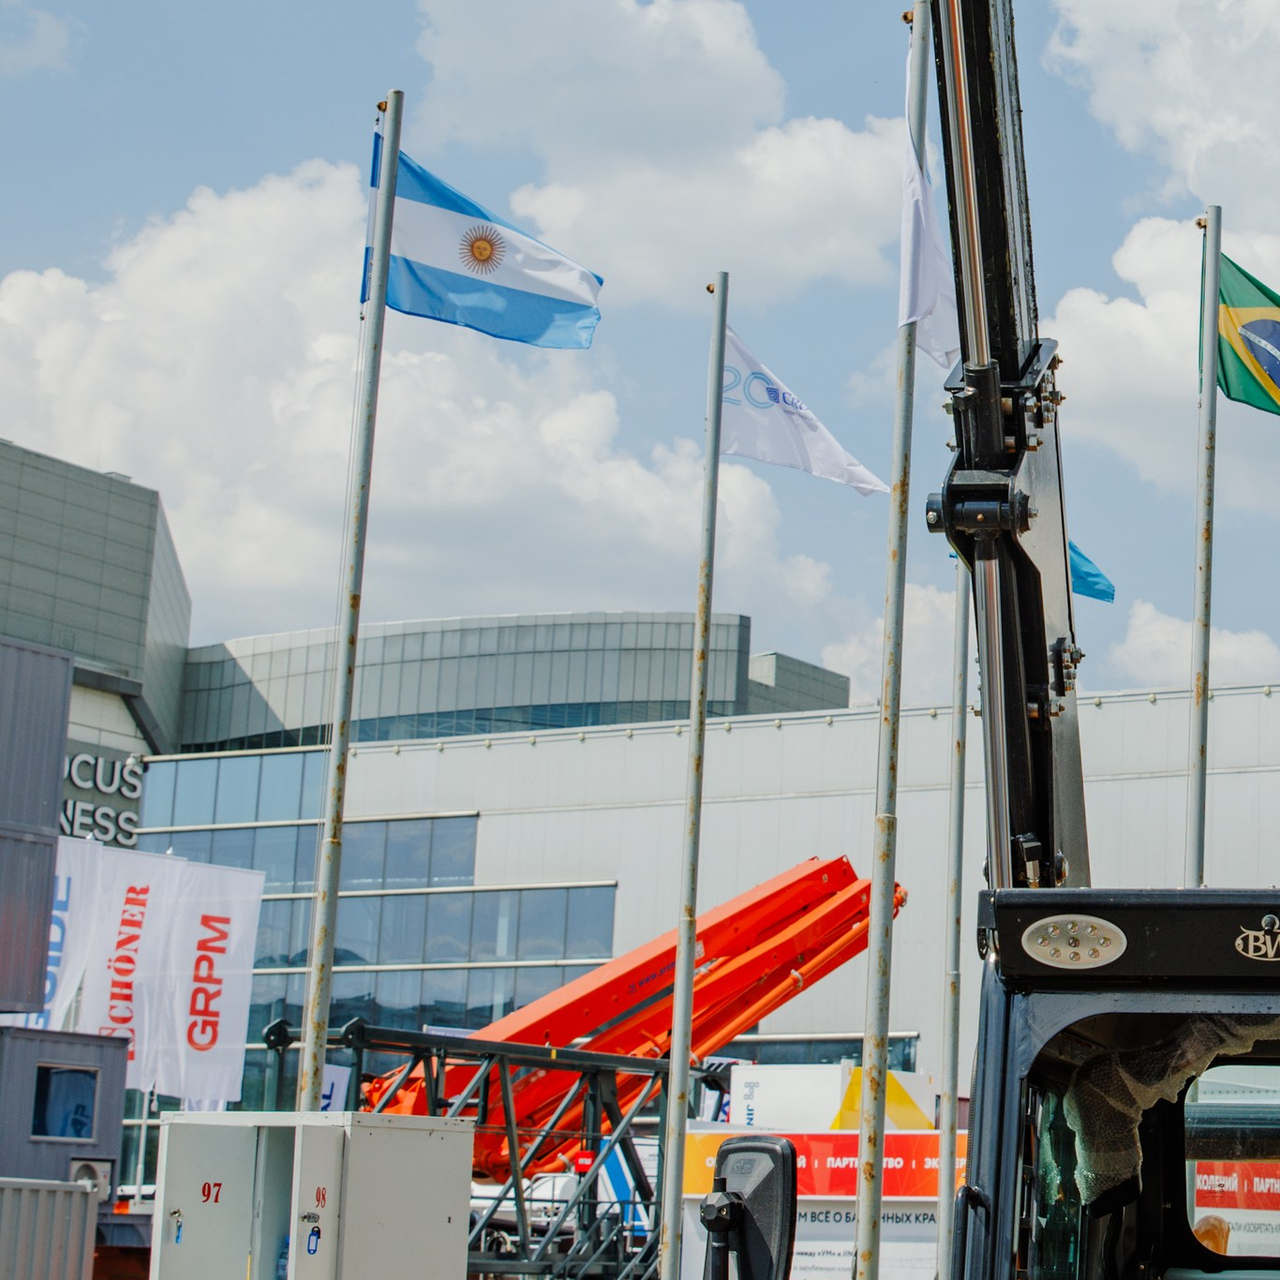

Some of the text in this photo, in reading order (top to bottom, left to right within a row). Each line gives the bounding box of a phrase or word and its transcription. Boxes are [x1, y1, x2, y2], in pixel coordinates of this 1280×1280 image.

[68, 752, 143, 799] CUS
[187, 913, 231, 1052] GRPM
[201, 1181, 223, 1203] 97
[315, 1186, 327, 1208] 98
[810, 1209, 832, 1223] ВСЁ
[832, 1211, 843, 1223] О
